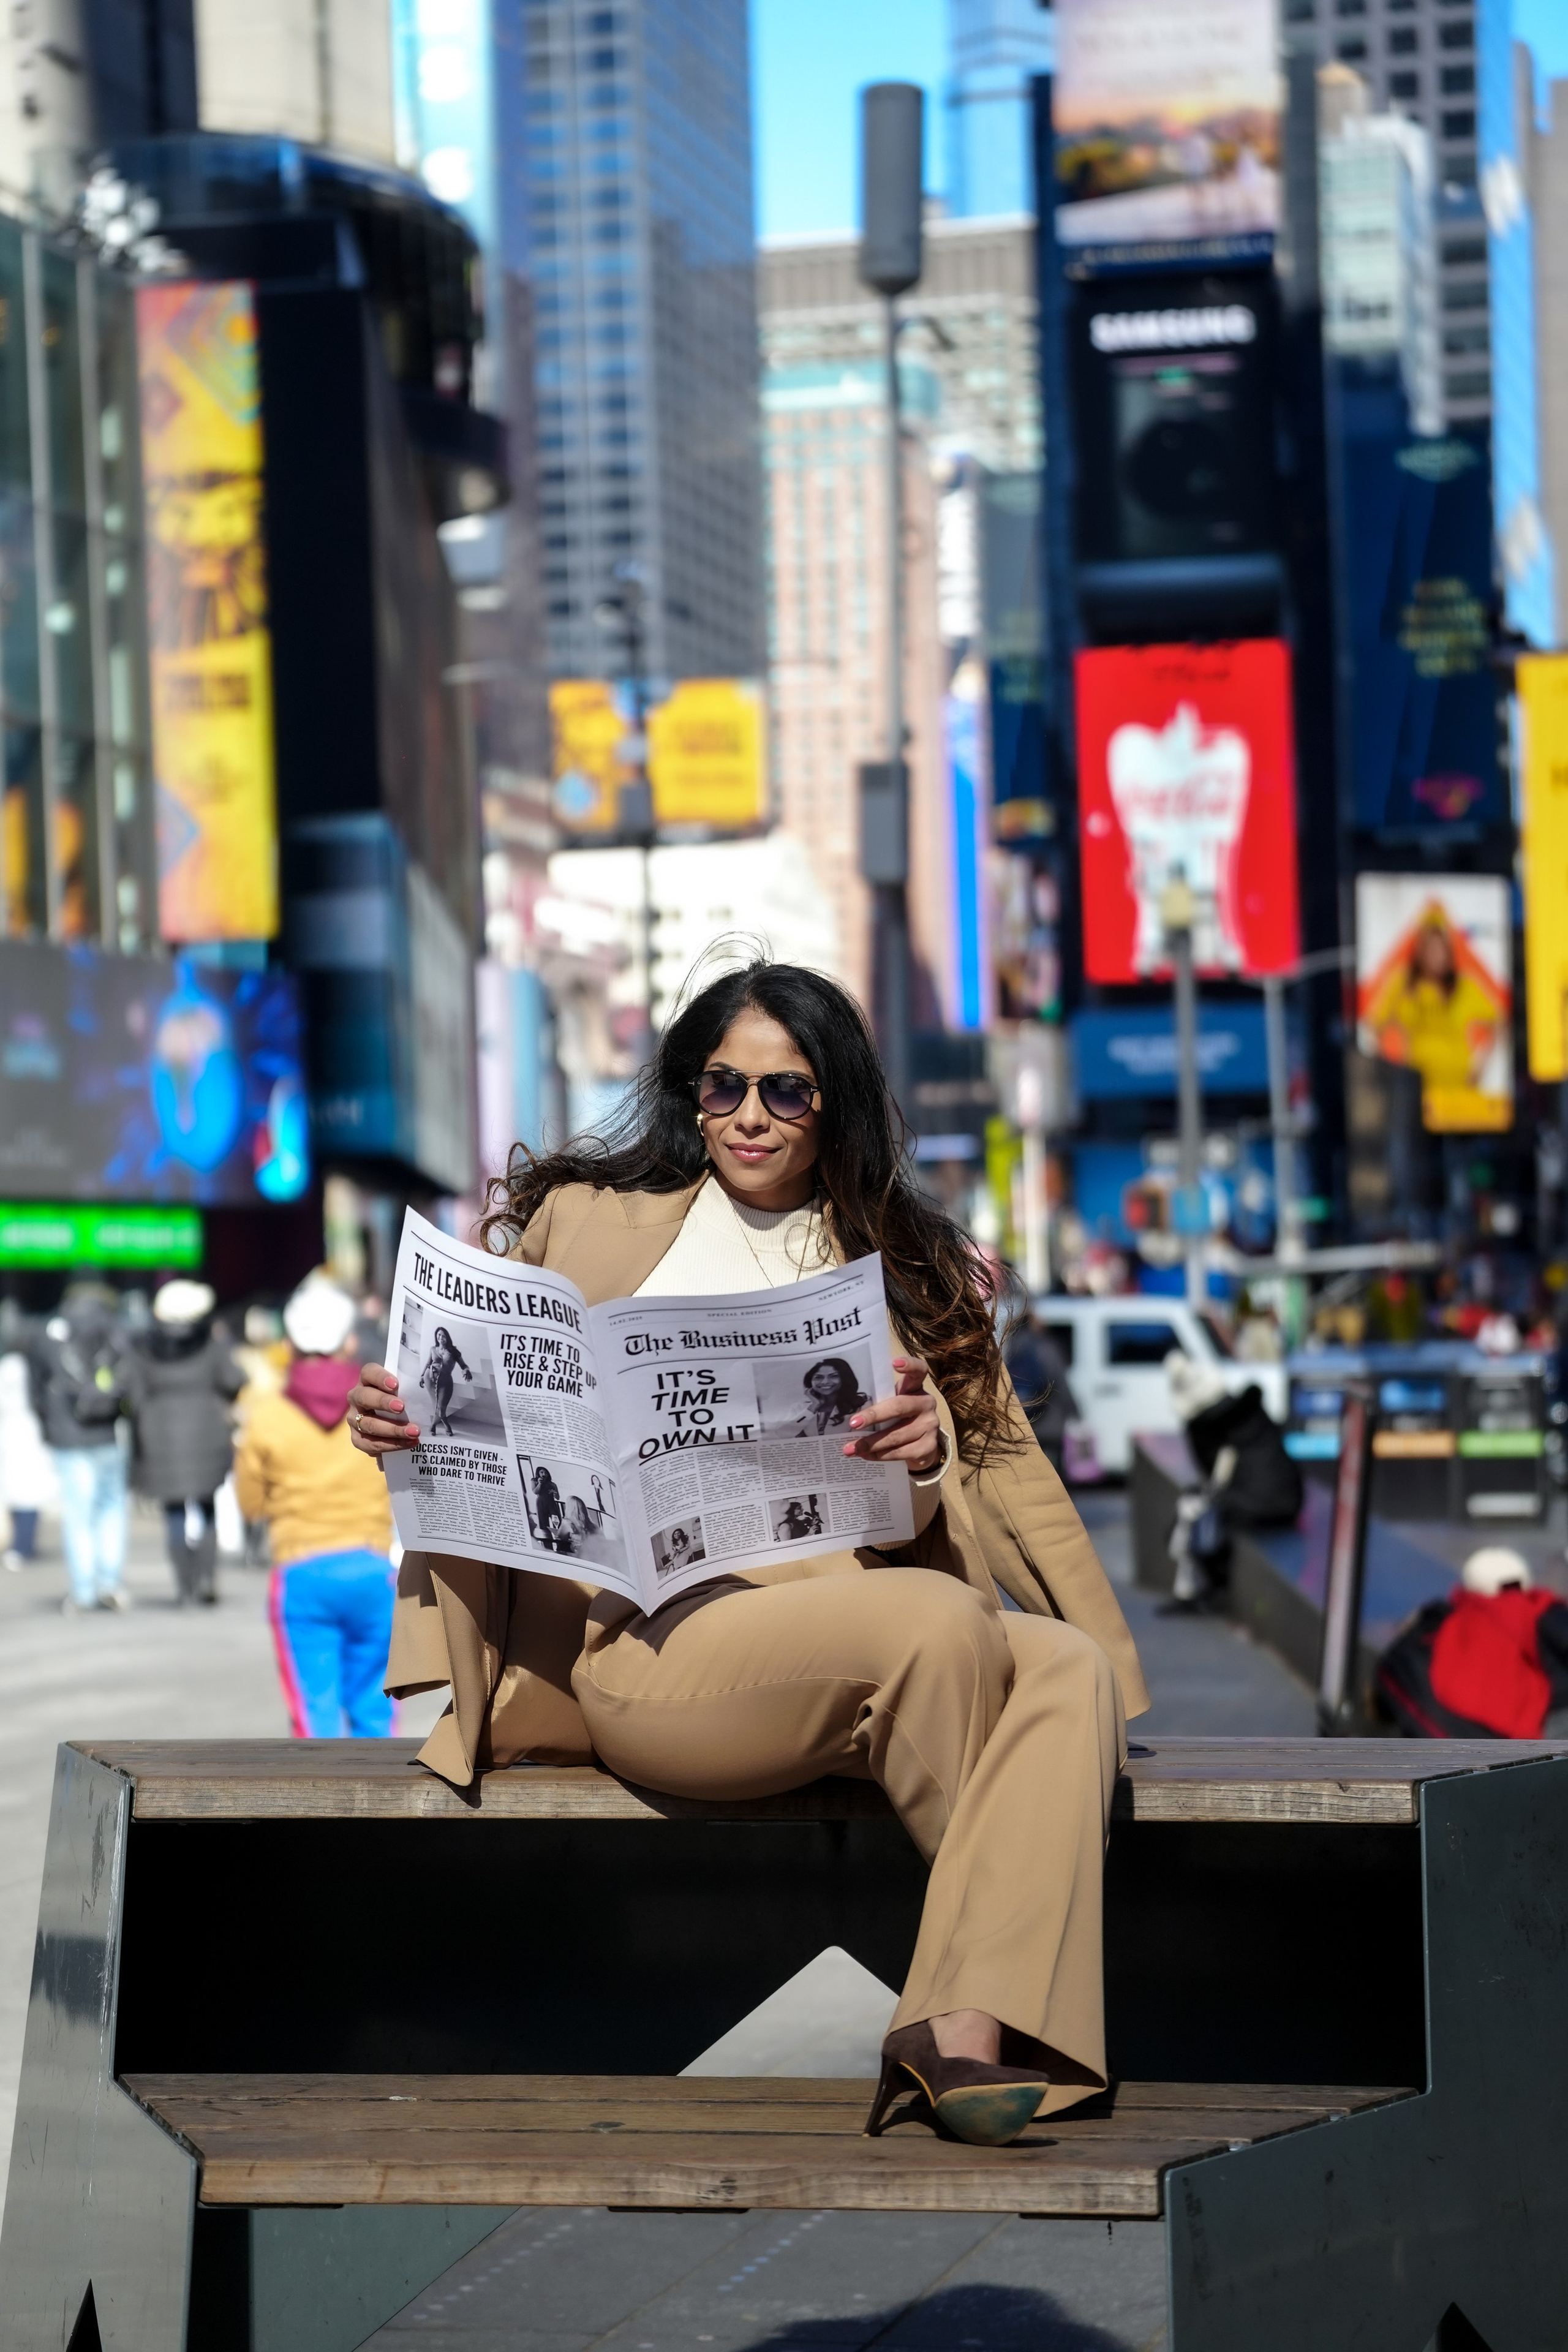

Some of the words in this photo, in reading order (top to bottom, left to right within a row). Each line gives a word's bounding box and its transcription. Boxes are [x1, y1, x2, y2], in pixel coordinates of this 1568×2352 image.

[414, 1252, 434, 1291] THE
[437, 1268, 510, 1314] LEADERS
[516, 1292, 582, 1335] LEAGUE
[624, 1333, 673, 1357] The
[678, 1328, 797, 1349] Business
[803, 1307, 862, 1345] Post
[500, 1333, 526, 1352] IT'S
[530, 1337, 562, 1357] TIME
[567, 1344, 580, 1363] TO
[503, 1352, 534, 1370] RISE
[538, 1356, 549, 1372] &
[552, 1359, 583, 1381] STEP
[586, 1371, 597, 1390] UP
[507, 1370, 543, 1389] YOUR
[547, 1376, 583, 1398] GAME
[657, 1370, 717, 1390] IT'S
[651, 1387, 730, 1411] TIME
[668, 1409, 714, 1427] TO
[450, 1446, 472, 1458] ISN'T
[474, 1449, 499, 1462] GIVEN
[639, 1427, 716, 1460] OWN
[728, 1424, 755, 1441] IT
[412, 1455, 428, 1464] IT'S
[429, 1455, 467, 1469] CLAIMED
[469, 1460, 479, 1471] BY
[481, 1463, 507, 1476] THOSE
[418, 1466, 438, 1476] WHO
[440, 1468, 462, 1479] DARE
[464, 1471, 475, 1481] TO
[477, 1472, 505, 1486] THRIVE
